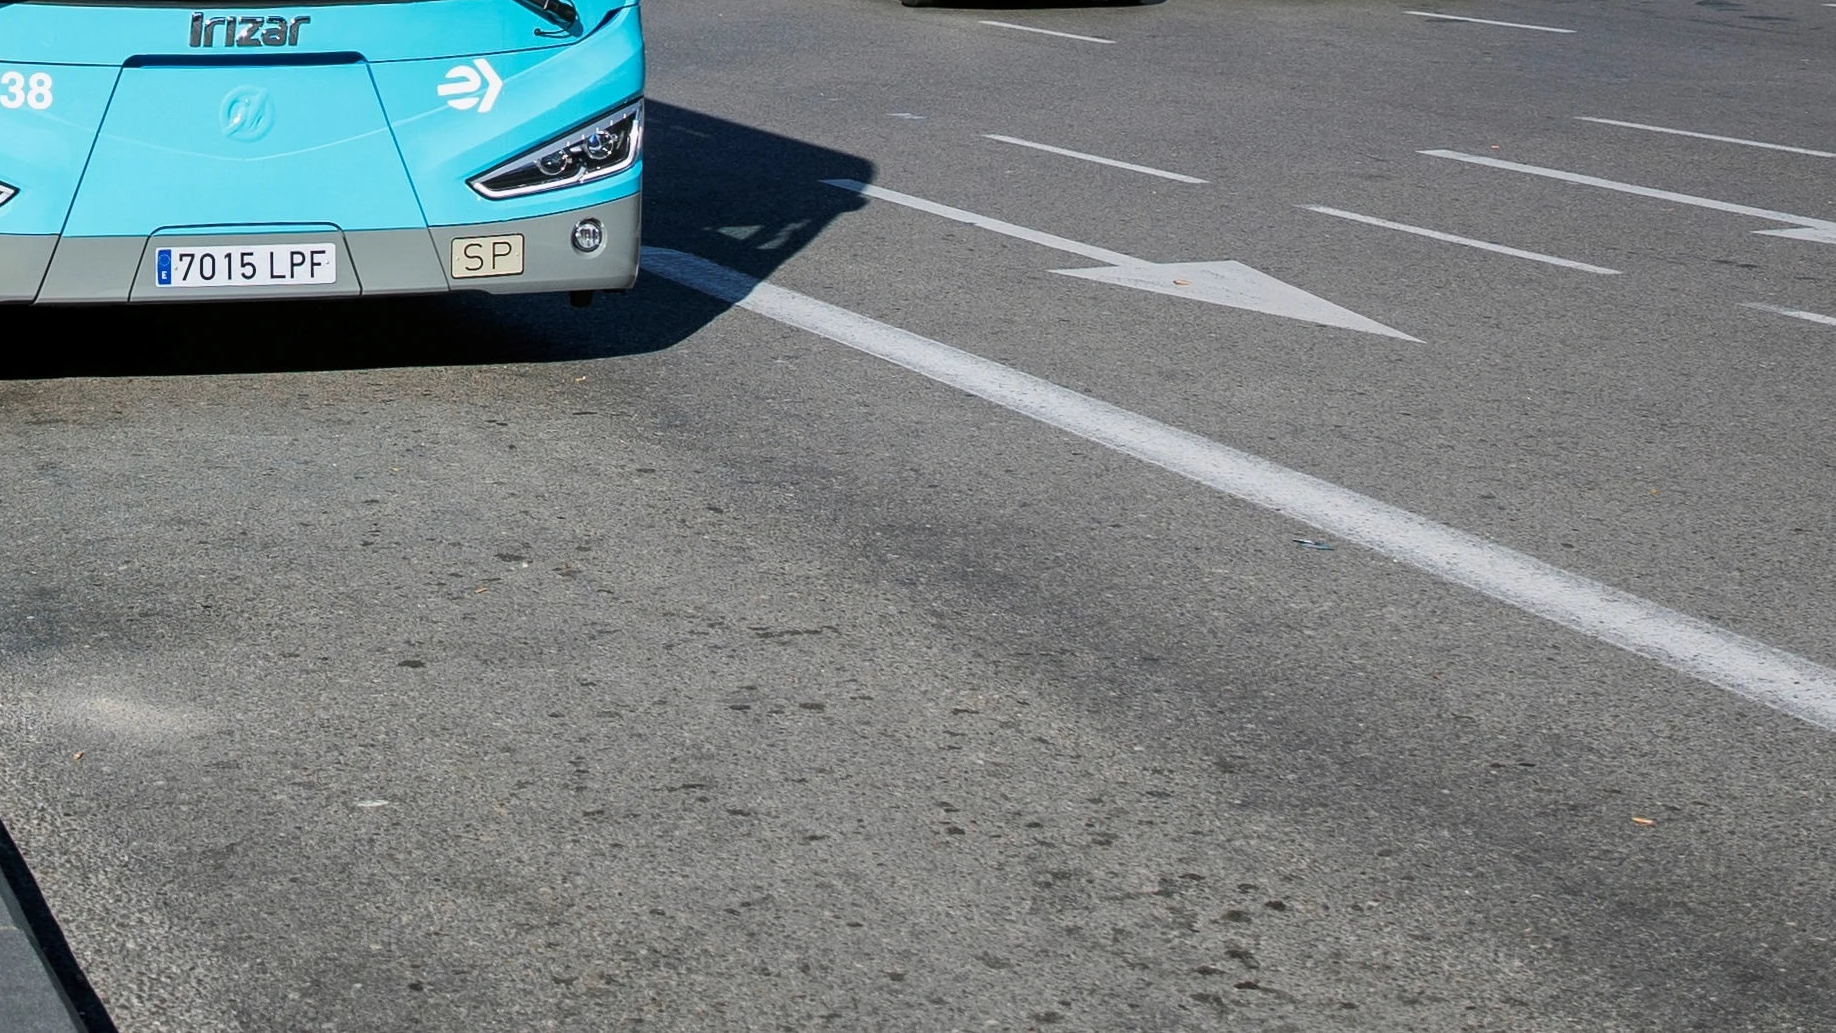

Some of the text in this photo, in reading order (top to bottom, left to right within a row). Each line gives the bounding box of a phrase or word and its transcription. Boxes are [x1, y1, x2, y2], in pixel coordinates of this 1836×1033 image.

[177, 252, 258, 282] 7015
[268, 249, 327, 280] LPF
[463, 240, 513, 272] SP
